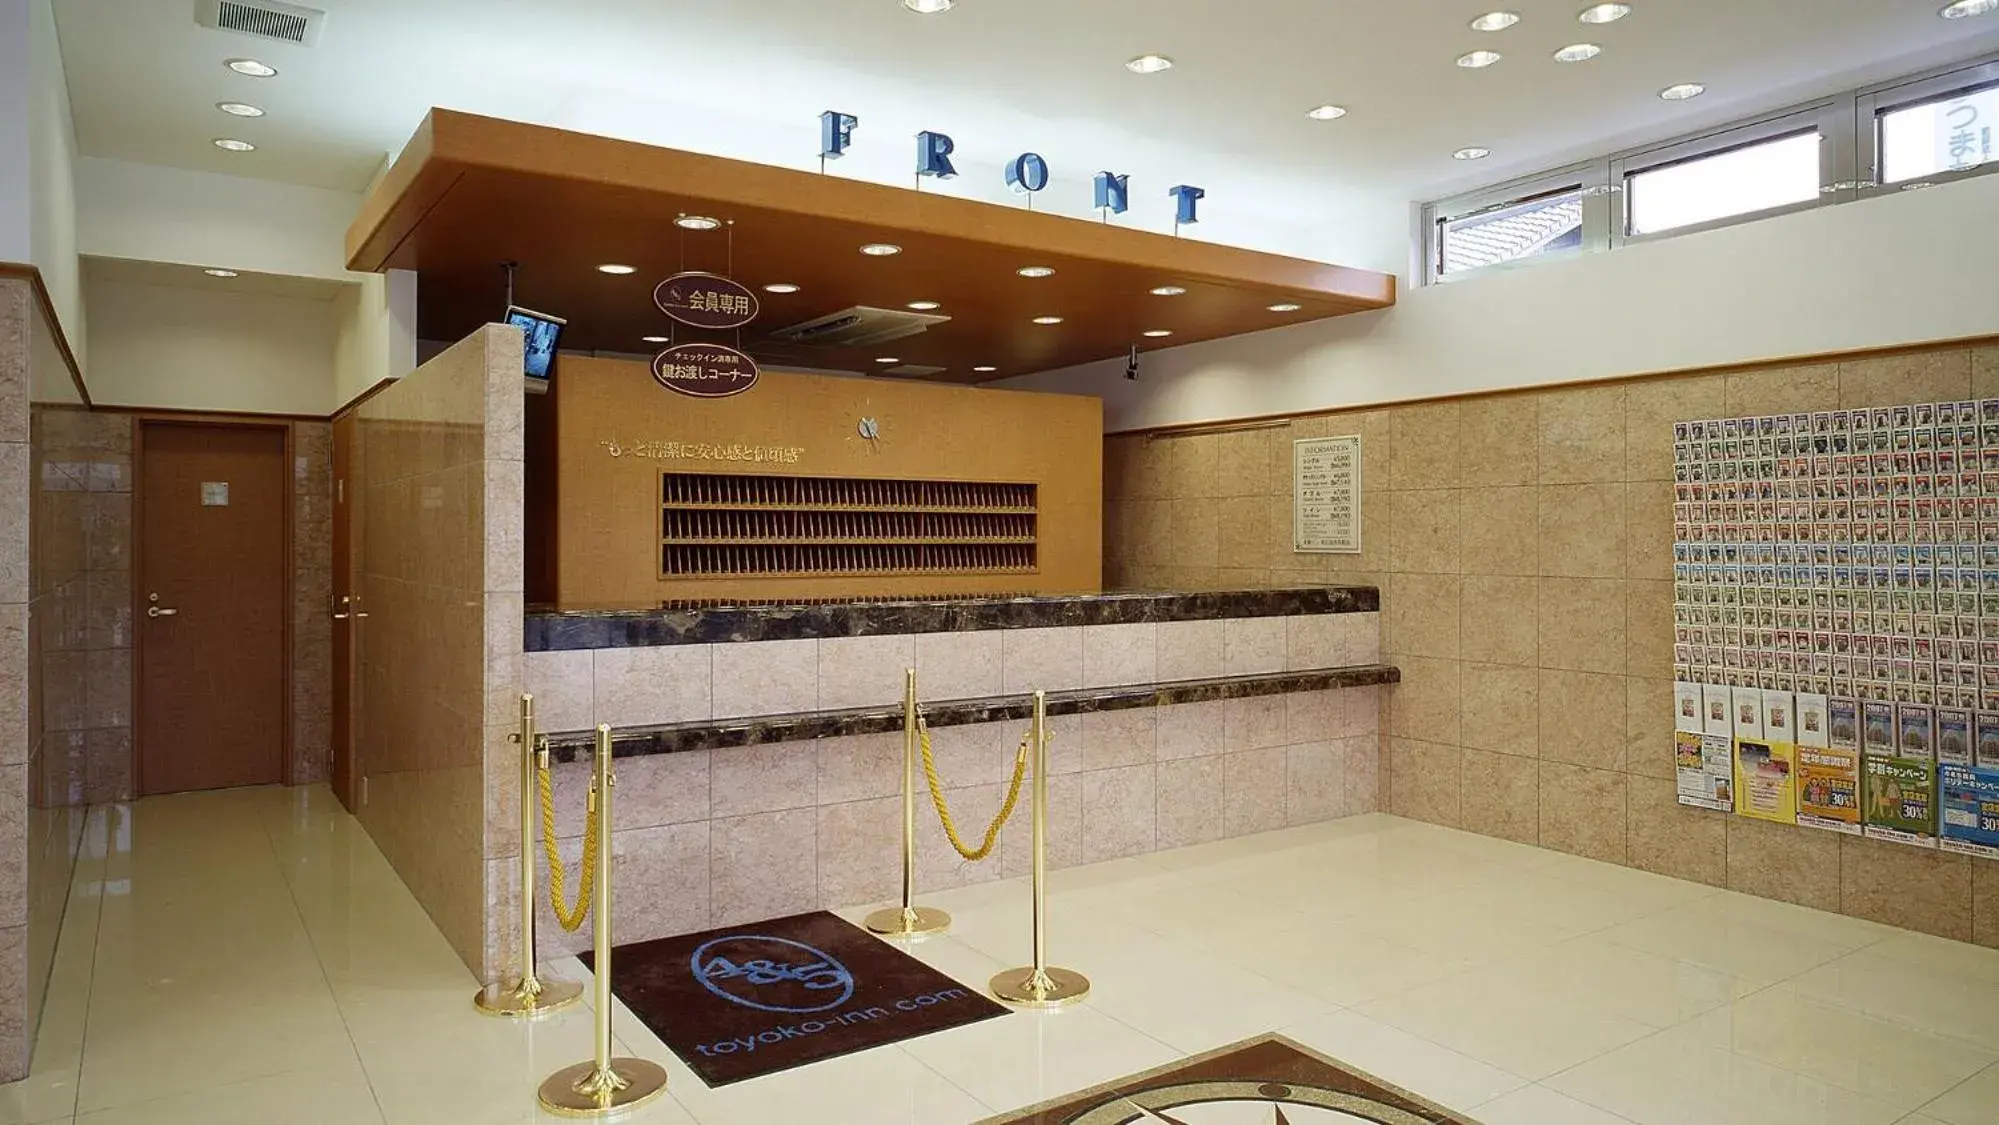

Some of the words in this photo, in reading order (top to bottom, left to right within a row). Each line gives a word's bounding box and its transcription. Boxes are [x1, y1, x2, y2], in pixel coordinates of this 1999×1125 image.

[818, 110, 1205, 225] FRONT
[688, 290, 750, 316] 会員専用
[661, 363, 753, 382] 鍵お渡しコーナー
[695, 987, 969, 1057] toyoko-inn.com
